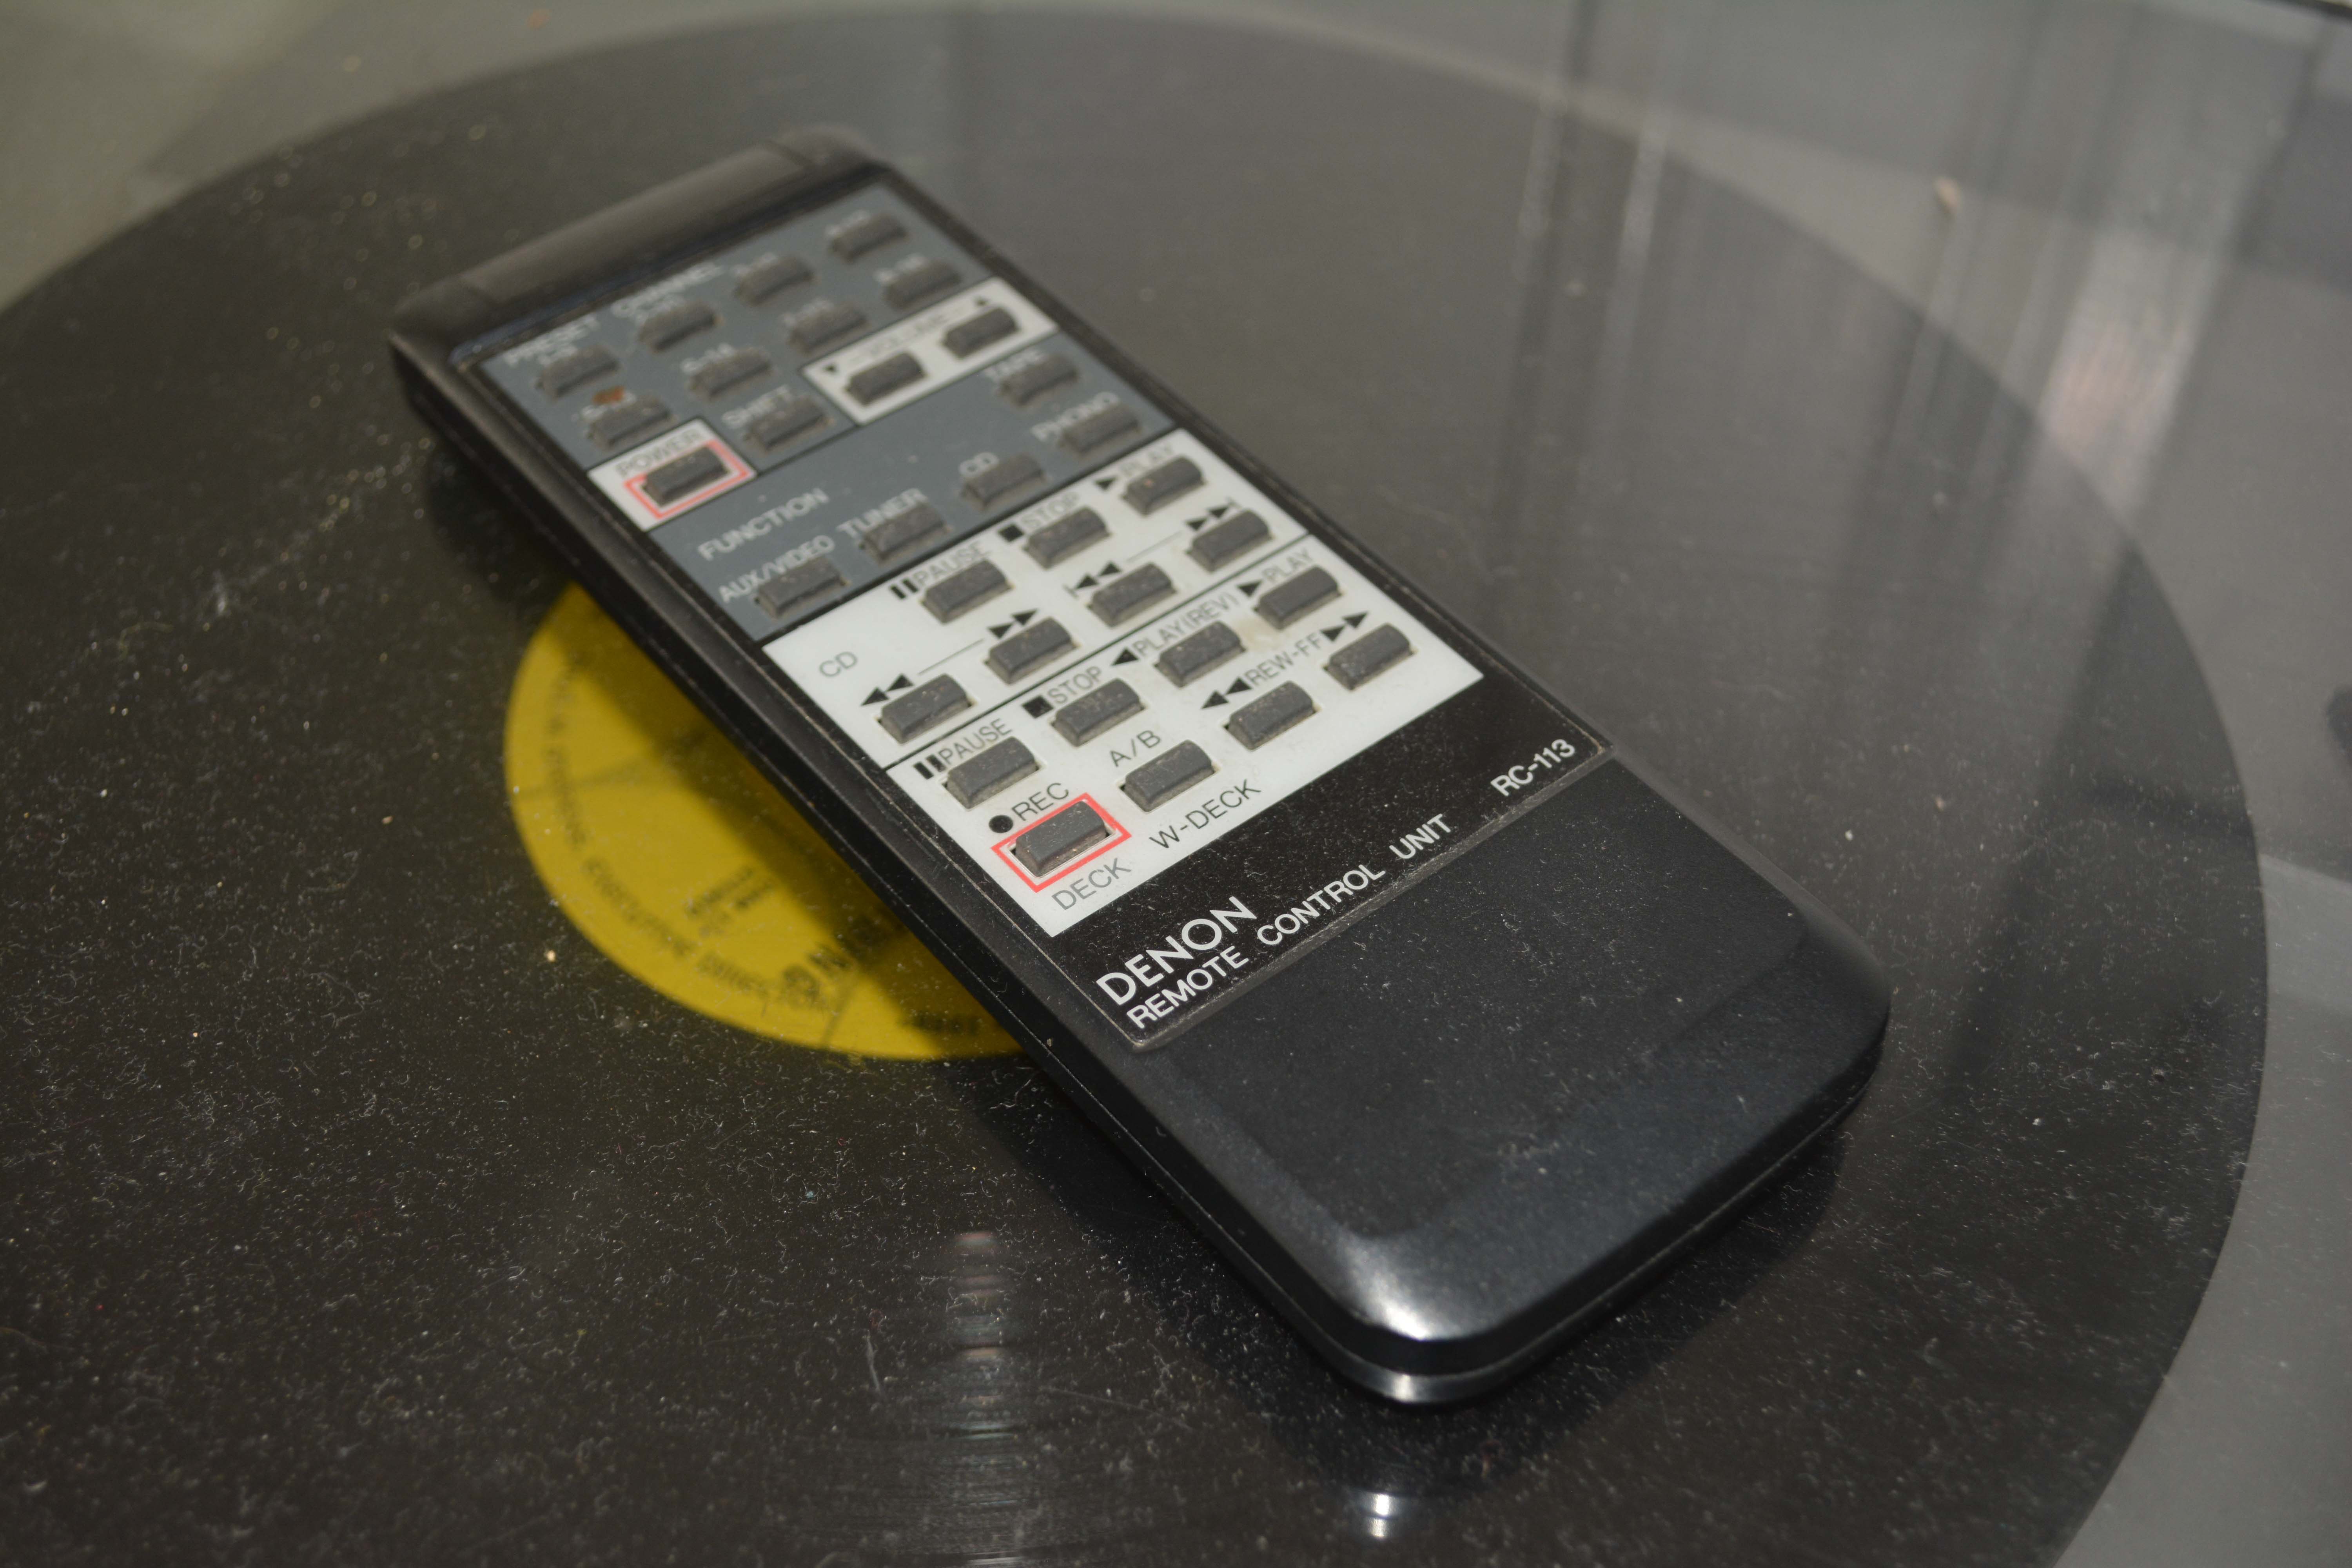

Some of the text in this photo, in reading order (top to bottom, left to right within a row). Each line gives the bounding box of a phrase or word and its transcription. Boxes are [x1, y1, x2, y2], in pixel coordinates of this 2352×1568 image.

[1030, 391, 1119, 441] PHONO
[615, 428, 703, 475] POWER
[959, 452, 999, 477] CD
[1119, 443, 1174, 478] PLAY
[697, 487, 831, 561] FUNCTION
[836, 487, 930, 539] TUNER
[1022, 492, 1080, 527] STOP
[718, 534, 835, 603] AUX/VIDEO
[915, 540, 987, 587] PAUSE
[1263, 548, 1314, 586] PLAY
[1136, 591, 1241, 659] PLAY(REV)
[818, 651, 858, 678] CD
[1245, 632, 1323, 686] REW-FF
[1048, 666, 1103, 706] STOP
[938, 718, 1013, 766] PAUSE
[1109, 729, 1161, 767] A/B
[1490, 739, 1576, 797] RC-113
[1011, 782, 1070, 822] REC
[1149, 779, 1261, 849] W-DECK
[1051, 857, 1132, 910] DECK
[1126, 813, 1451, 1029] REMOTE CONTROL UNIT
[1096, 896, 1257, 1006] DENON
